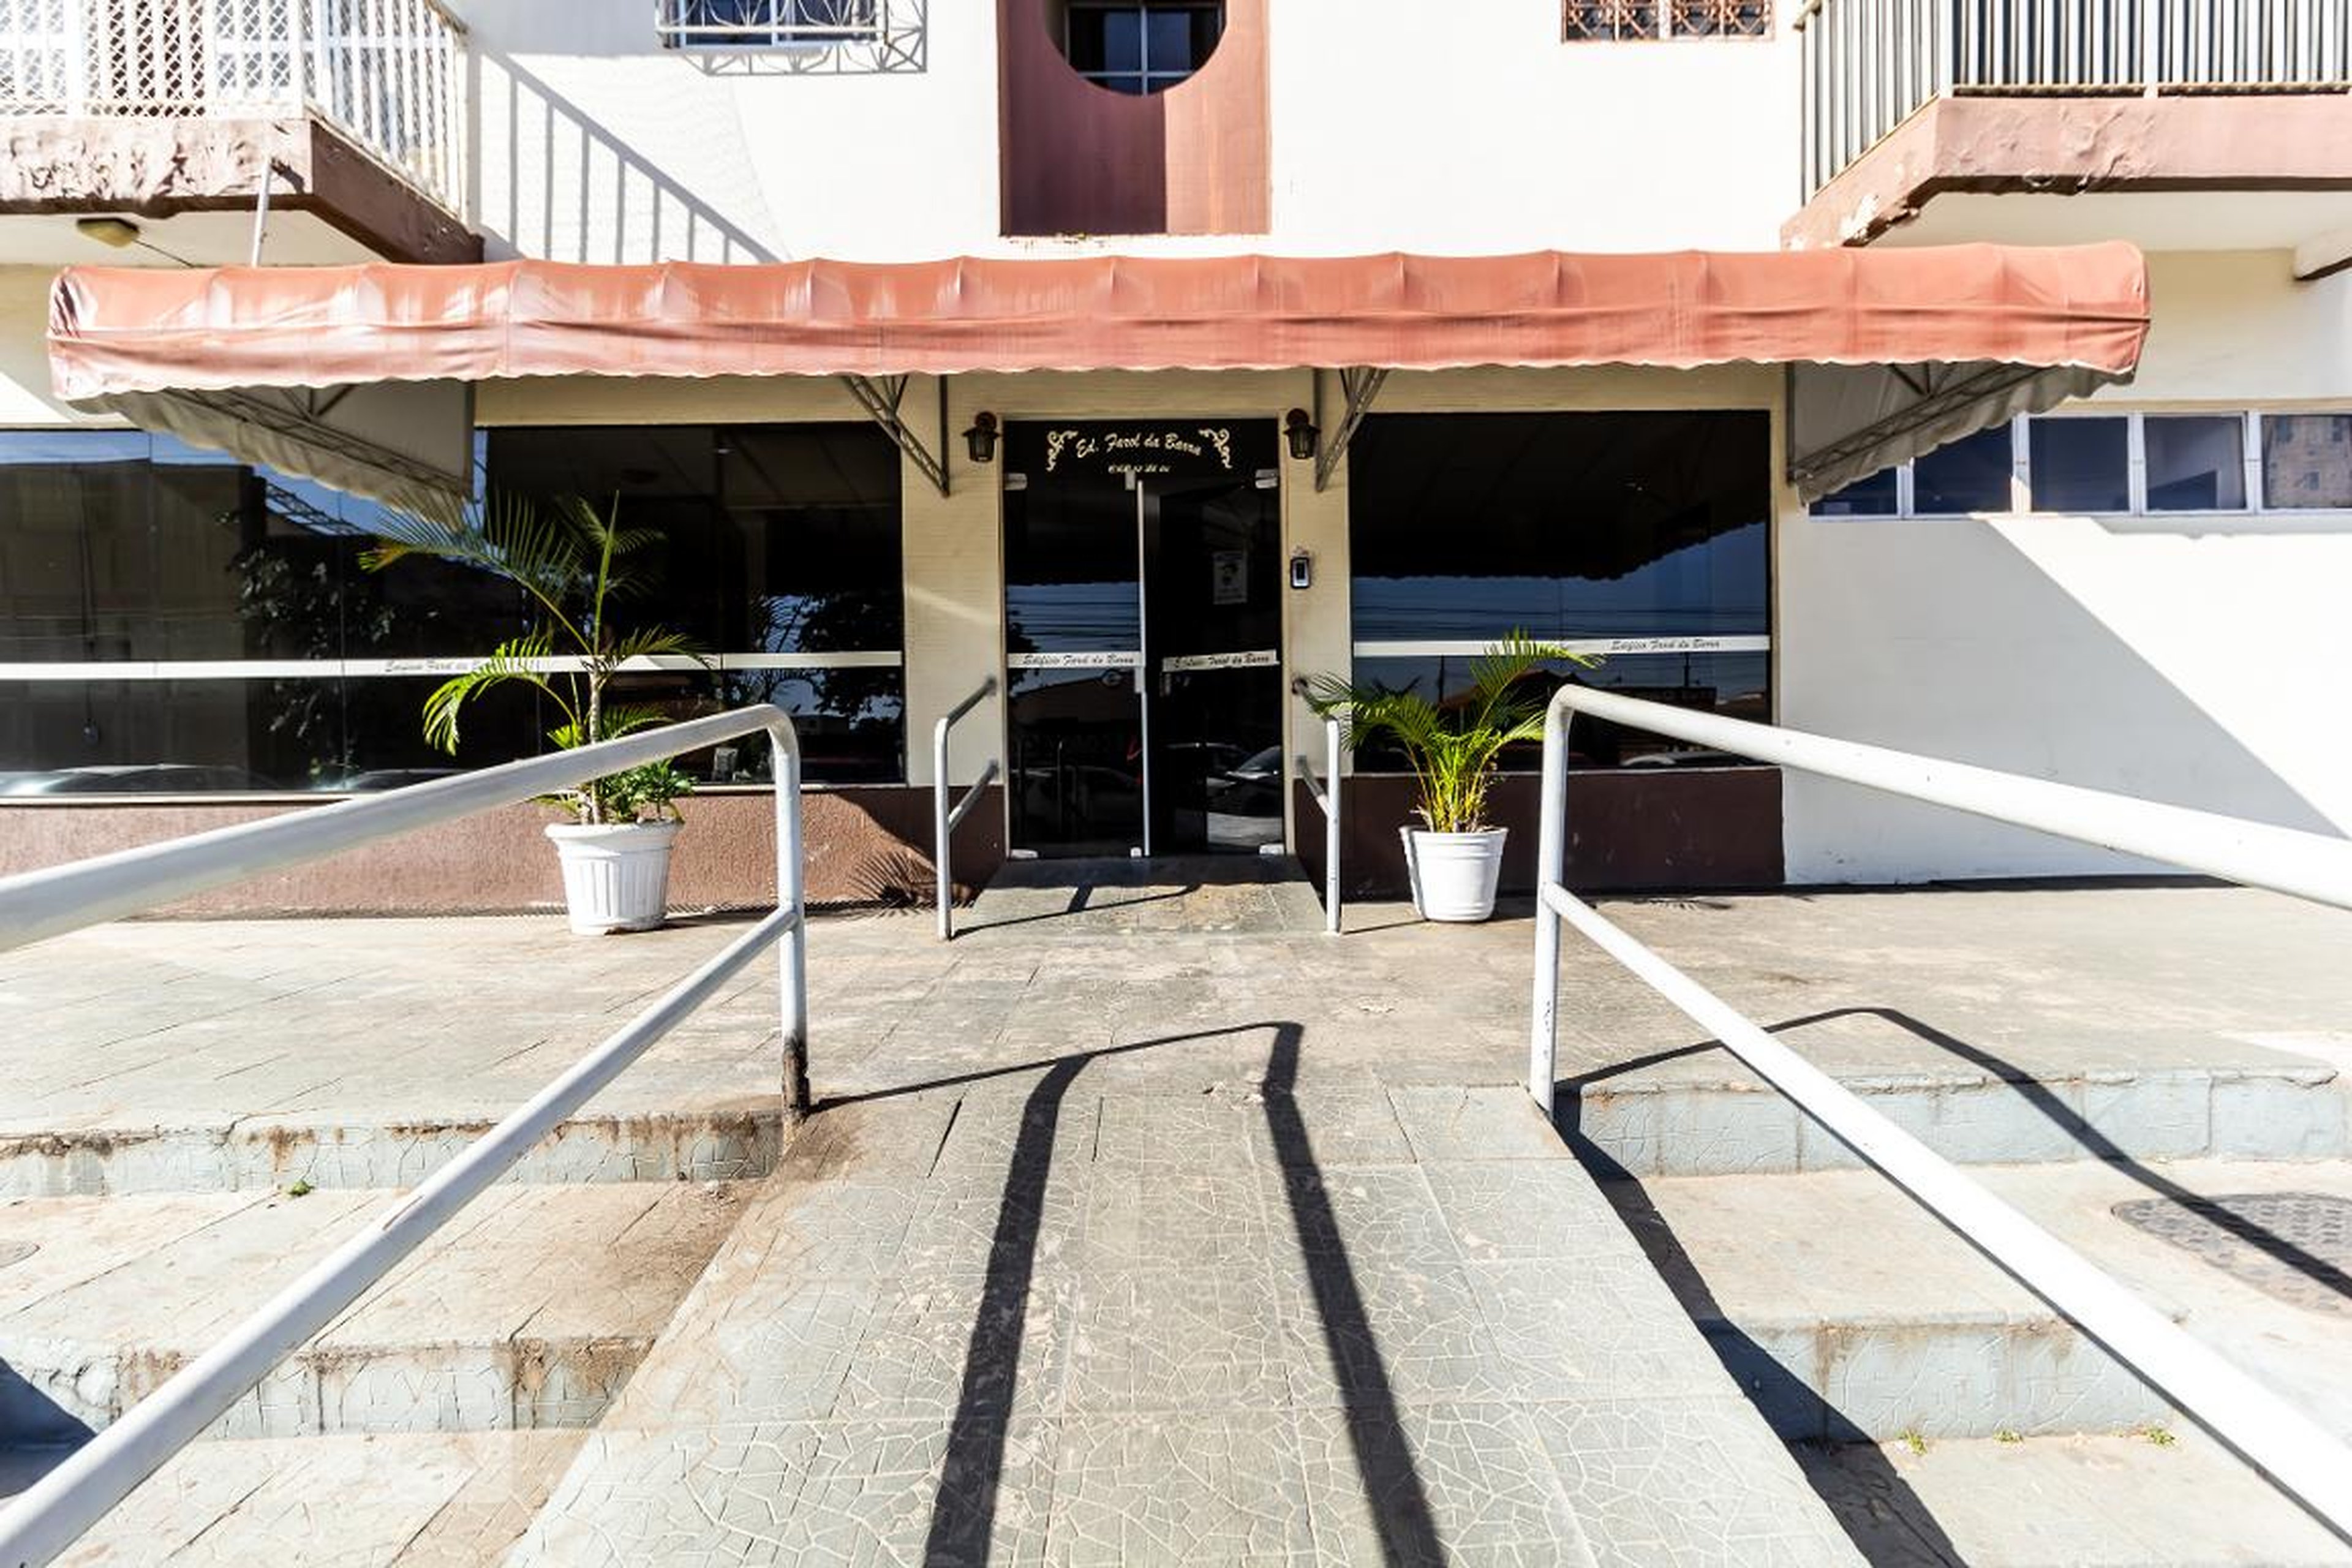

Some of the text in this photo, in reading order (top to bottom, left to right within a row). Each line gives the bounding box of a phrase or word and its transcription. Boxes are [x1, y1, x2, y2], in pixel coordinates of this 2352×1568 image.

[1076, 432, 1202, 458] Ed. Farol da Barra
